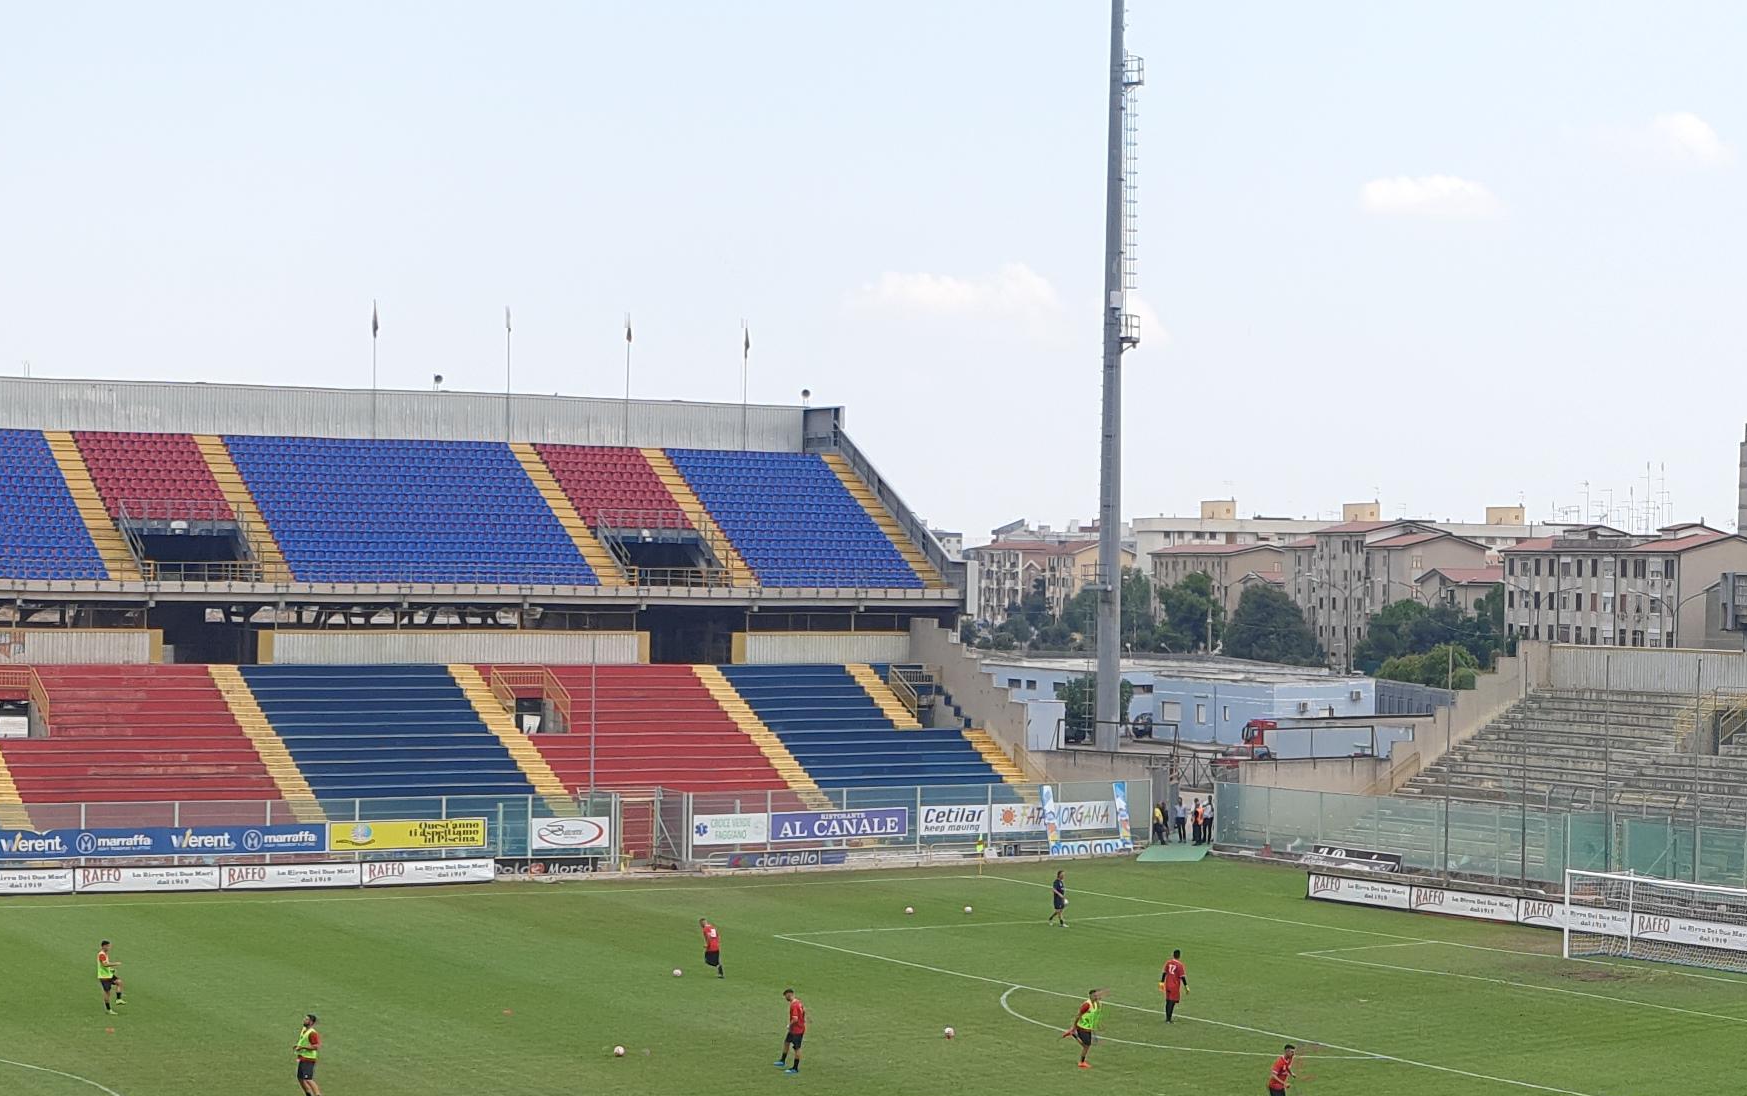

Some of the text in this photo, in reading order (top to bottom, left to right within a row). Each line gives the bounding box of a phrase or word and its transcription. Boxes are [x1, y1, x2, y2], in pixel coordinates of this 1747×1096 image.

[924, 807, 985, 824] Cetilar
[779, 817, 899, 838] AL CANALE
[1, 833, 61, 852] Werent
[97, 835, 152, 847] marraffa
[171, 828, 231, 849] Werent
[263, 832, 317, 843] marraffa
[755, 852, 818, 868] ciciriello
[82, 868, 122, 883] RAFFO
[228, 867, 267, 882] RAFFO
[368, 862, 405, 878] RAFFO
[1313, 876, 1341, 892] RAFFO
[1415, 887, 1445, 905] RAFFO
[1524, 901, 1554, 917] RAFFO
[1637, 915, 1671, 934] RAFFO
